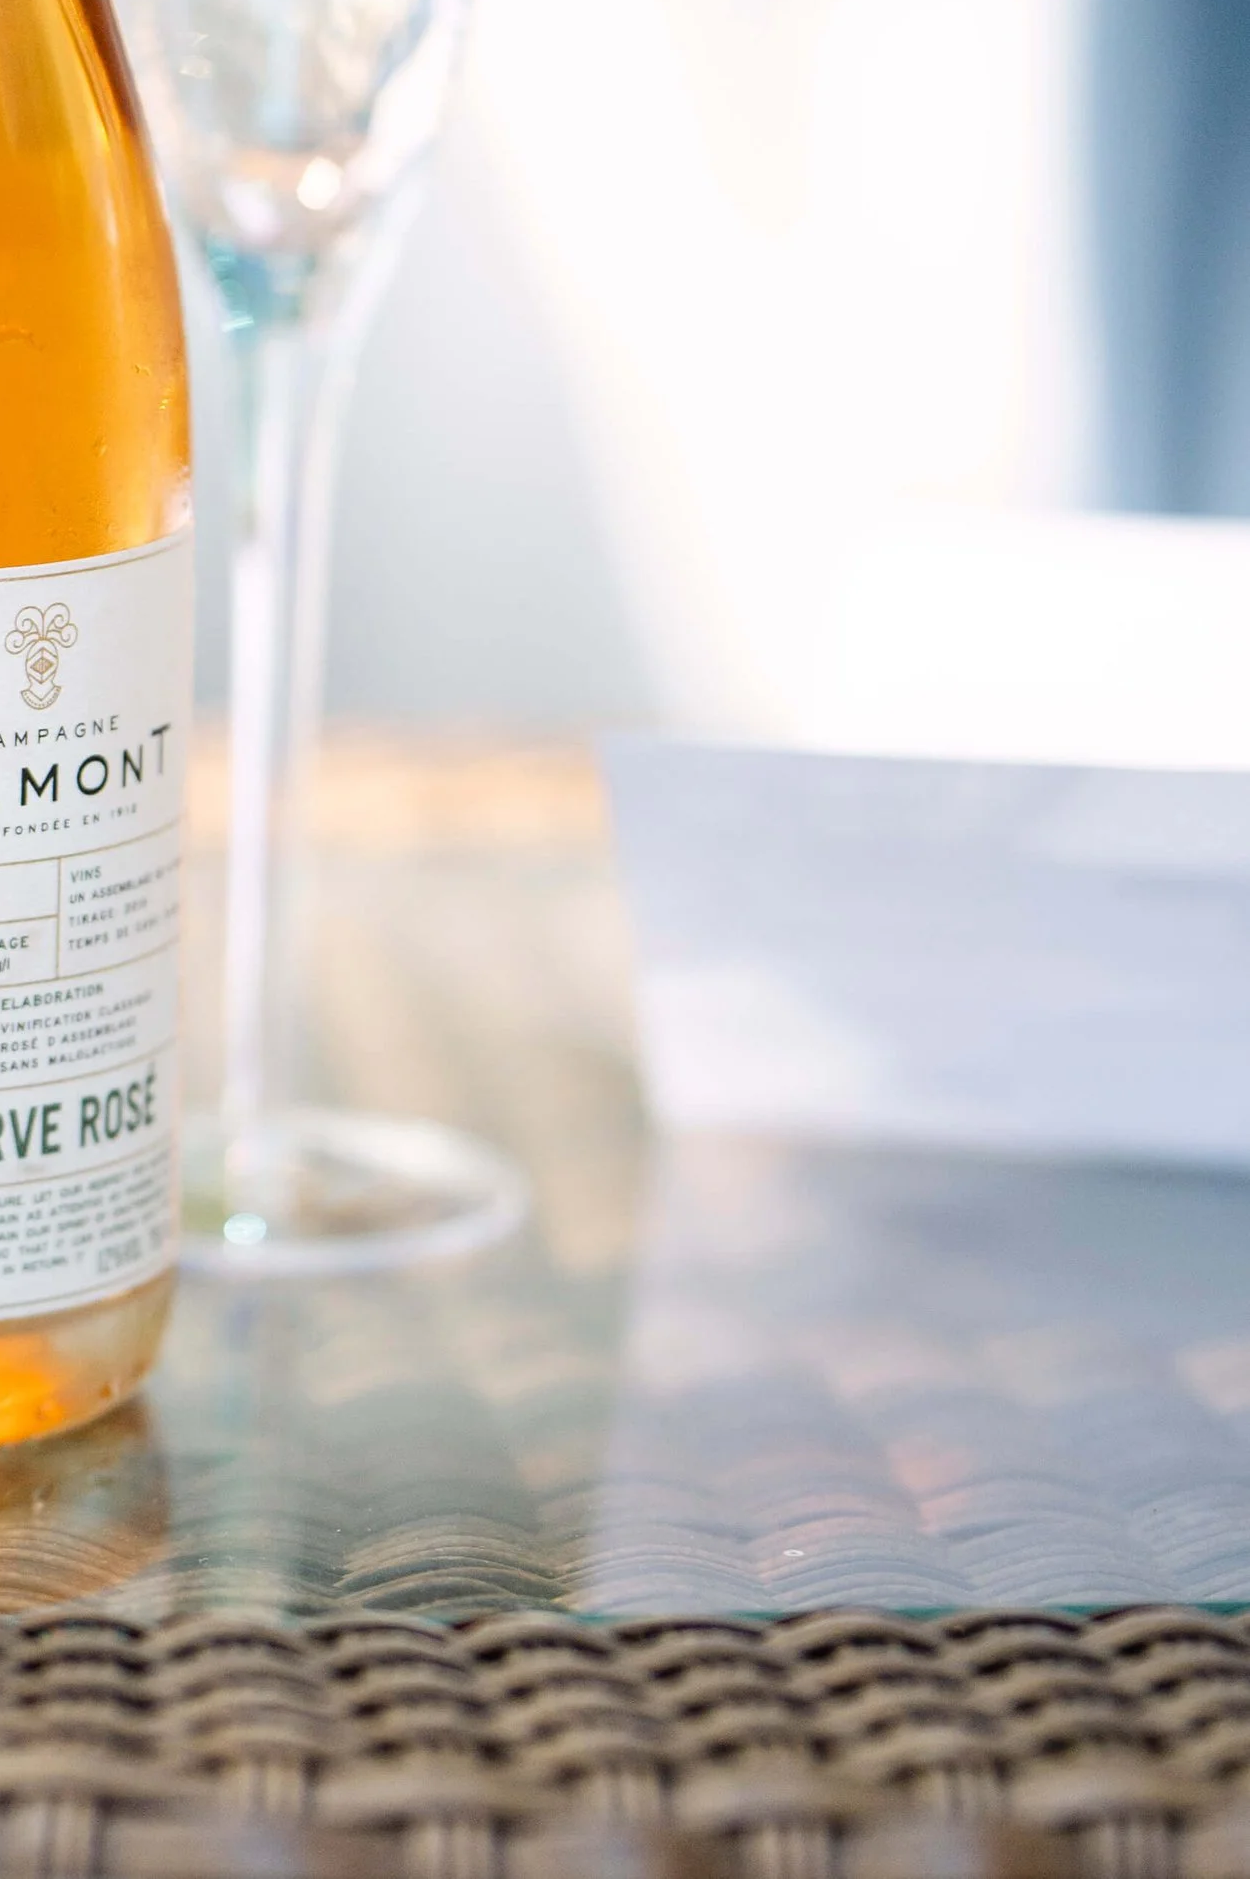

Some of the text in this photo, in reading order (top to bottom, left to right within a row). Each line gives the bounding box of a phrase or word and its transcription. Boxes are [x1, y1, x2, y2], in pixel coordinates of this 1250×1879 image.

[2, 818, 72, 837] FONDÉE
[82, 813, 101, 826] EN
[70, 865, 103, 884] VINS
[69, 891, 86, 905] UN
[0, 1059, 39, 1074] SANS
[78, 1061, 157, 1149] ROSÉ
